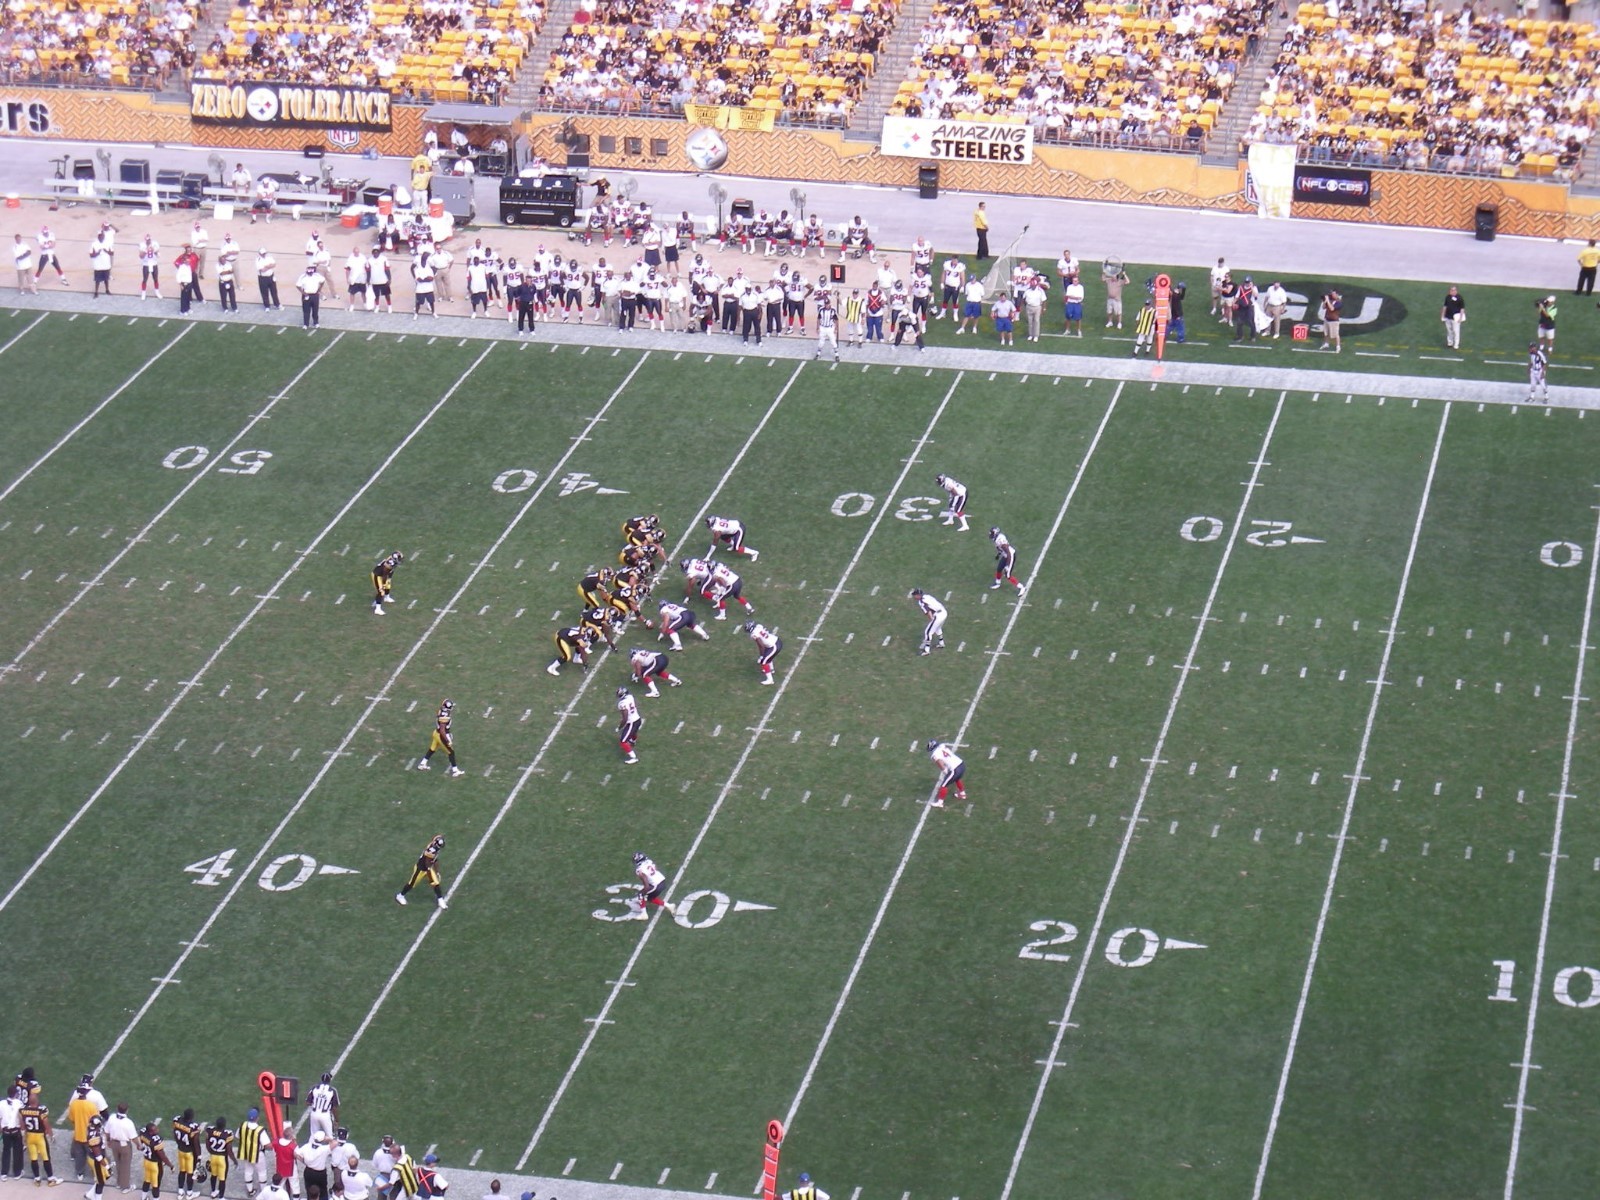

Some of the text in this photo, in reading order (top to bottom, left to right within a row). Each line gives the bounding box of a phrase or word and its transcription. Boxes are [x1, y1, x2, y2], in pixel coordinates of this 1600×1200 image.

[191, 83, 390, 125] ZERO TOLERANCE
[0, 102, 49, 132] rs
[332, 129, 355, 142] NFL
[932, 124, 1027, 142] AMAZING
[930, 139, 1025, 162] STEELERS
[1302, 178, 1363, 191] NFL CBS
[1295, 328, 1306, 340] 20
[25, 1117, 39, 1130] 51
[209, 1137, 226, 1152] 22
